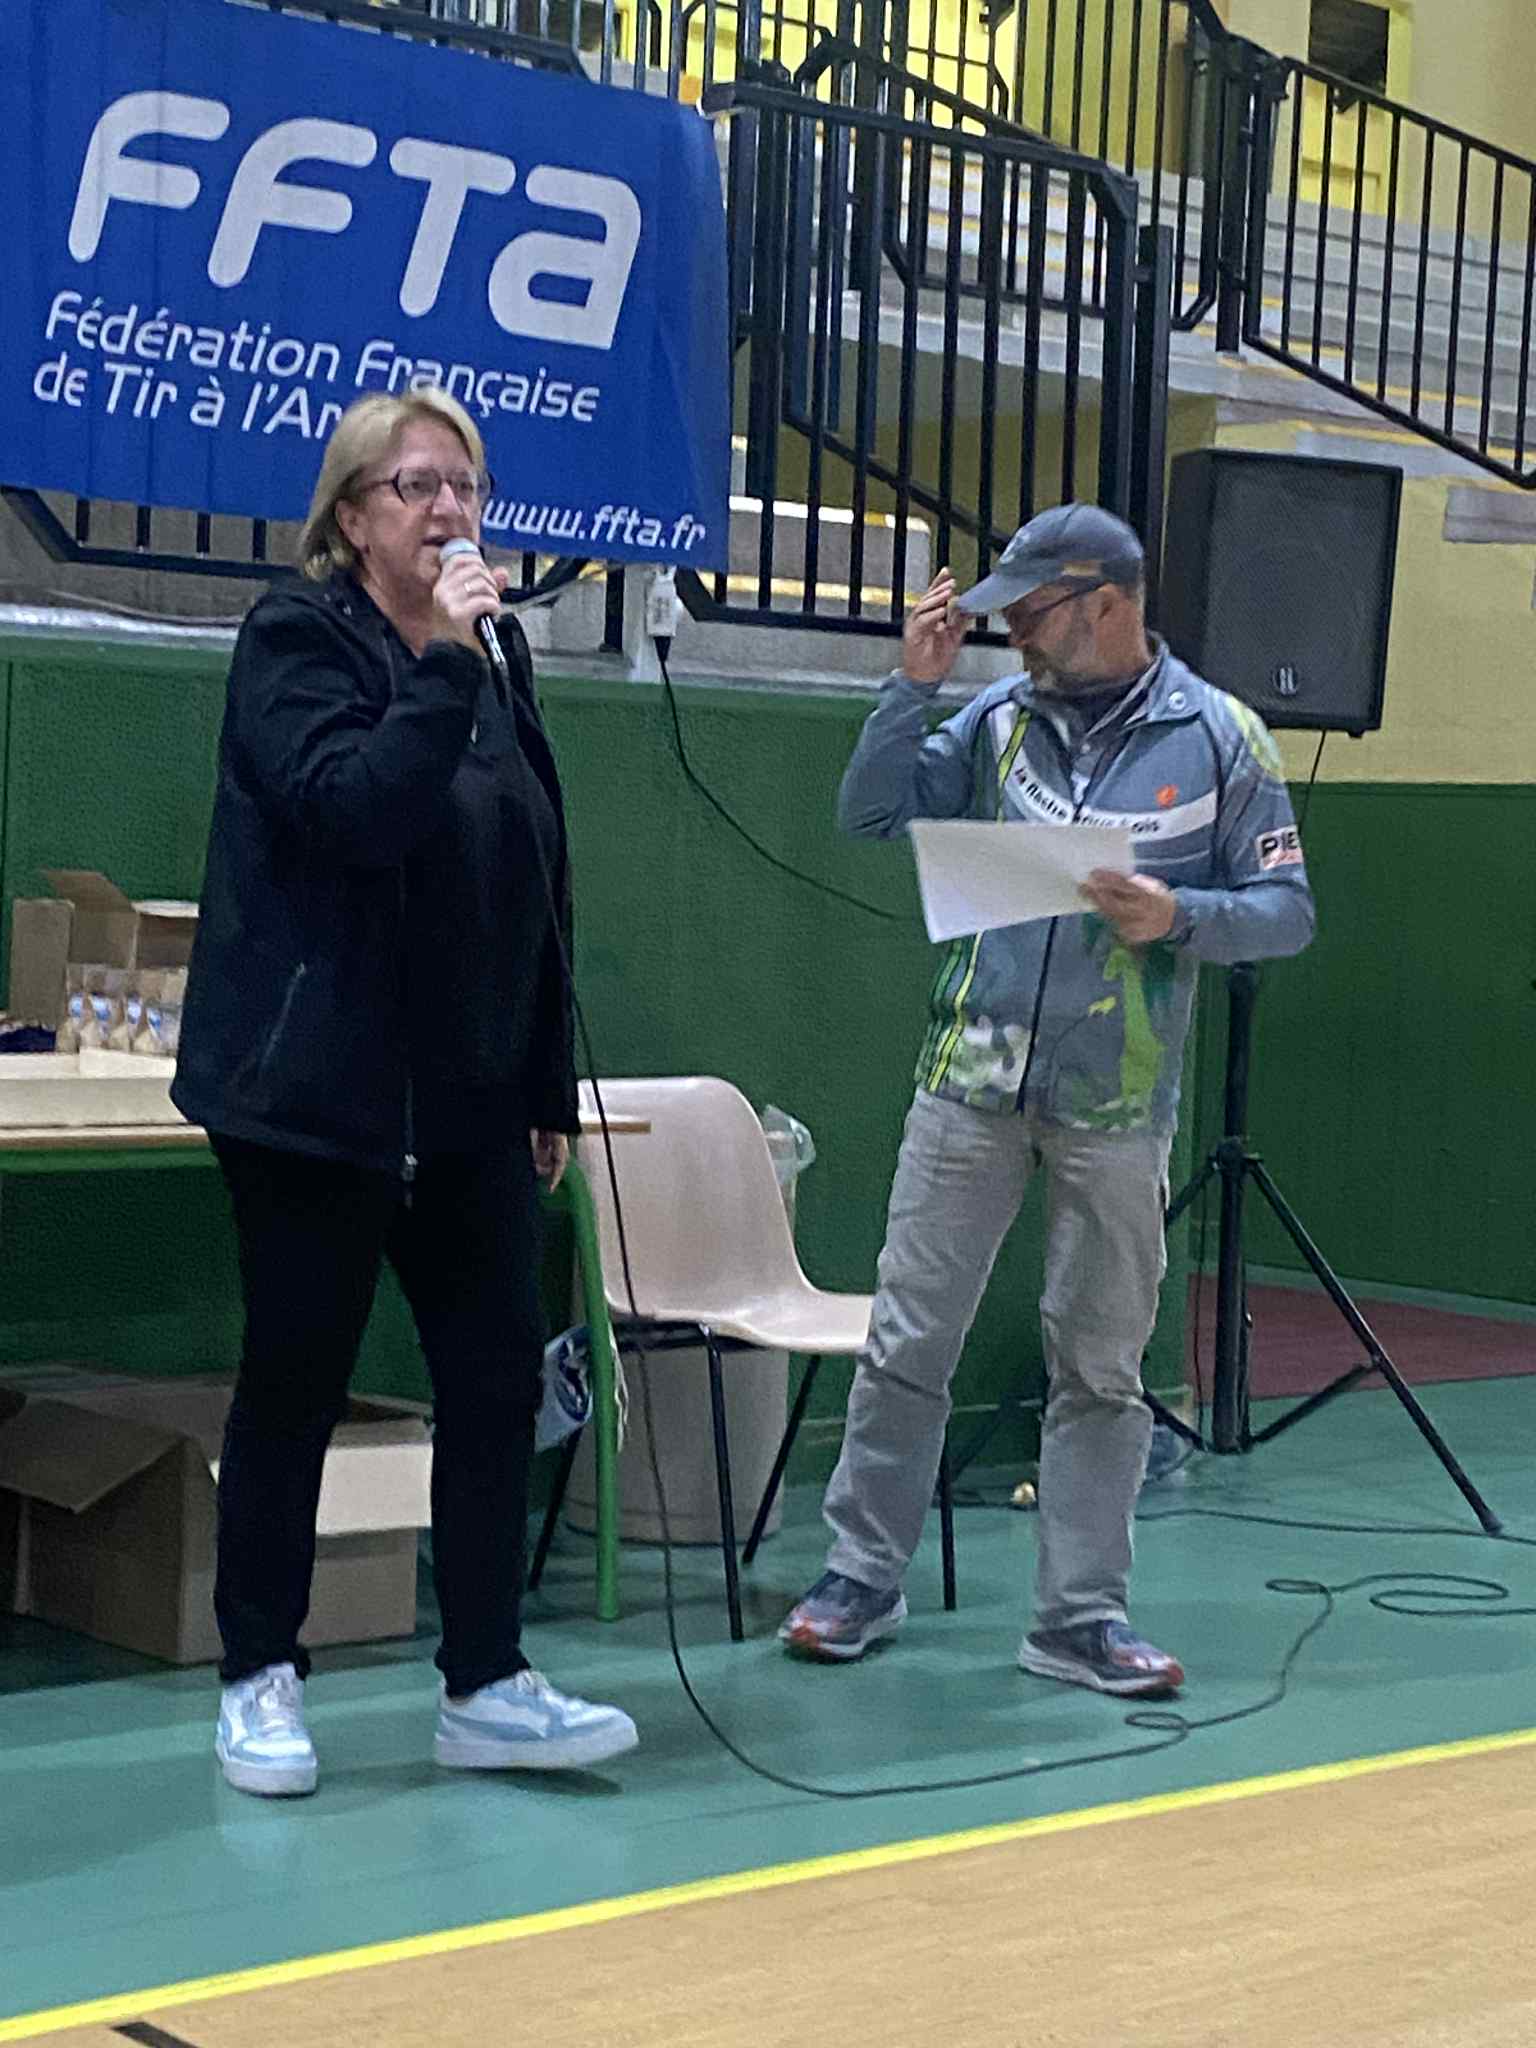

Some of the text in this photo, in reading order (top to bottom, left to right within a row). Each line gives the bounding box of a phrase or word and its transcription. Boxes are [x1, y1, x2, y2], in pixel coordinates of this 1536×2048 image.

[33, 351, 343, 439] de Tir à l'Ar
[45, 290, 600, 423] Fédération Française
[481, 499, 706, 551] www.ffta.fr
